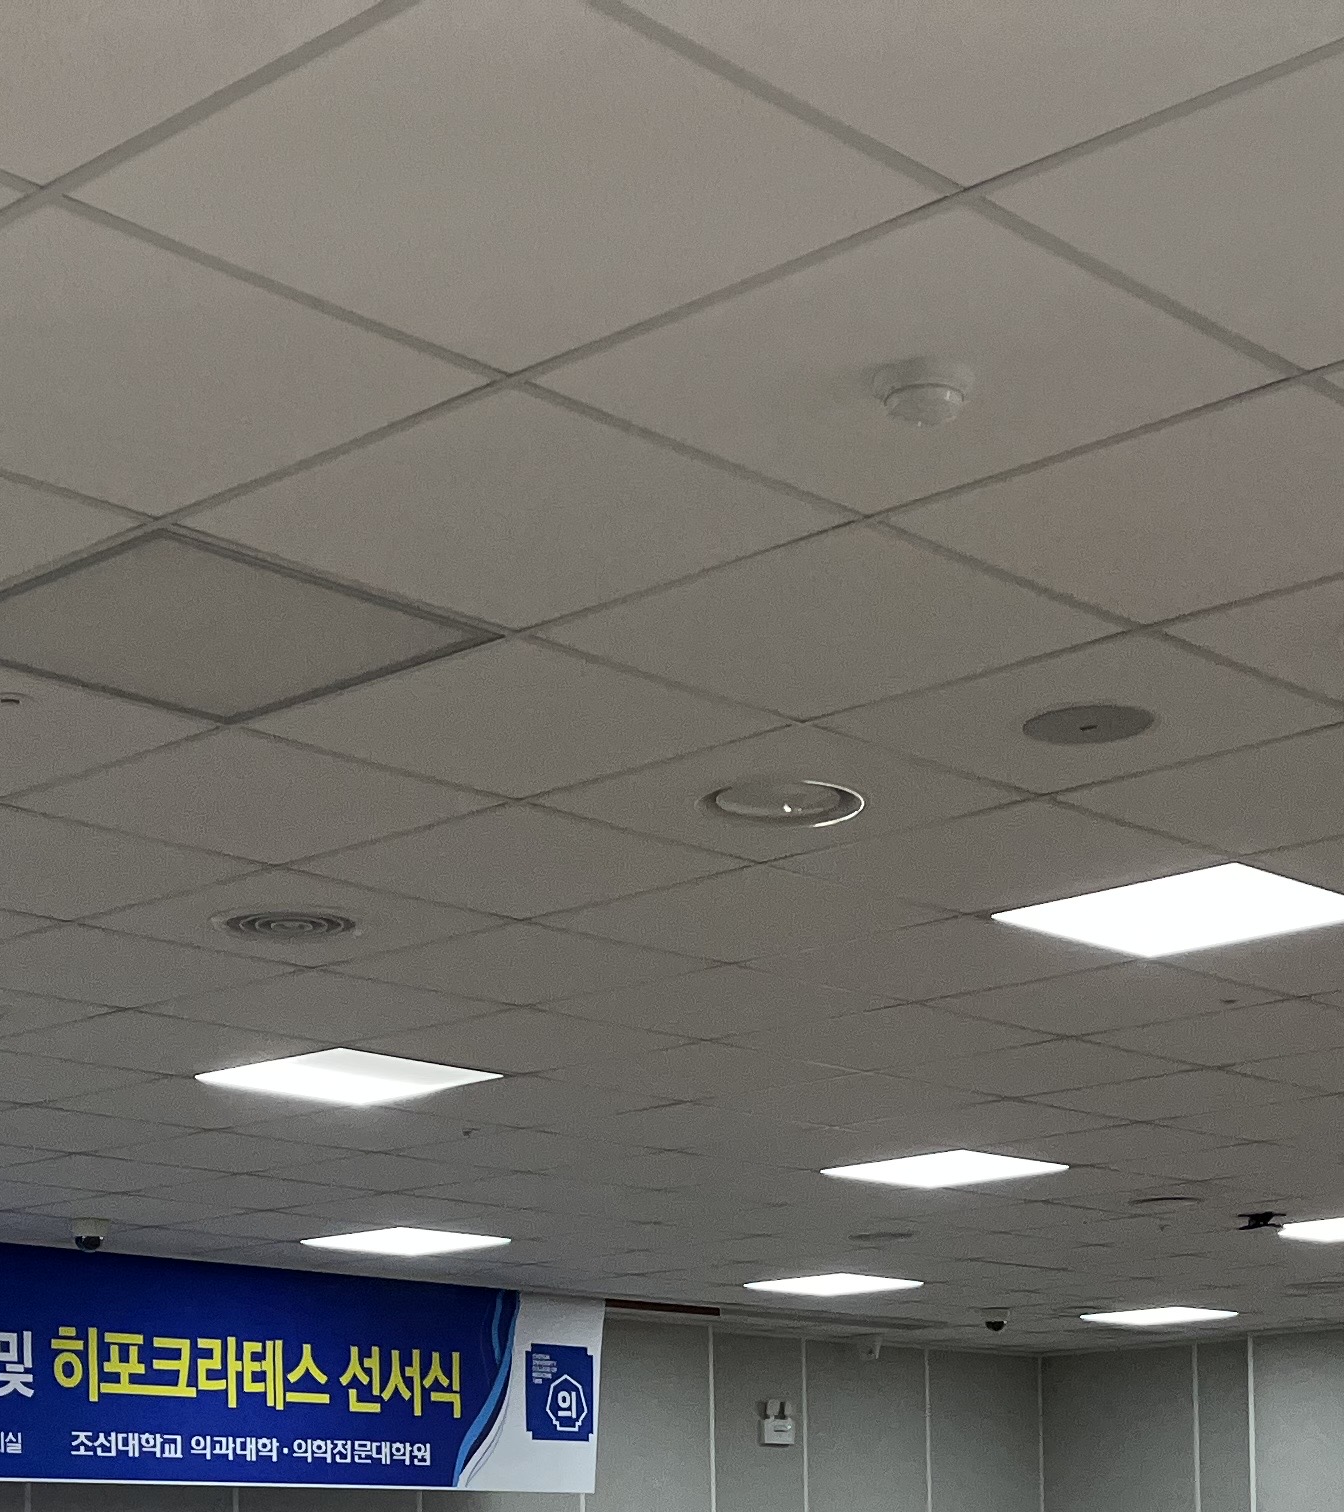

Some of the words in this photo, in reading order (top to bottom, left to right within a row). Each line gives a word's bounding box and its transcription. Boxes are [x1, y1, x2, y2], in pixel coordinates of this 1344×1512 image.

[51, 1327, 329, 1410] 히포크라테스
[340, 1346, 460, 1418] 선서식
[71, 1432, 182, 1458] 조선대학교
